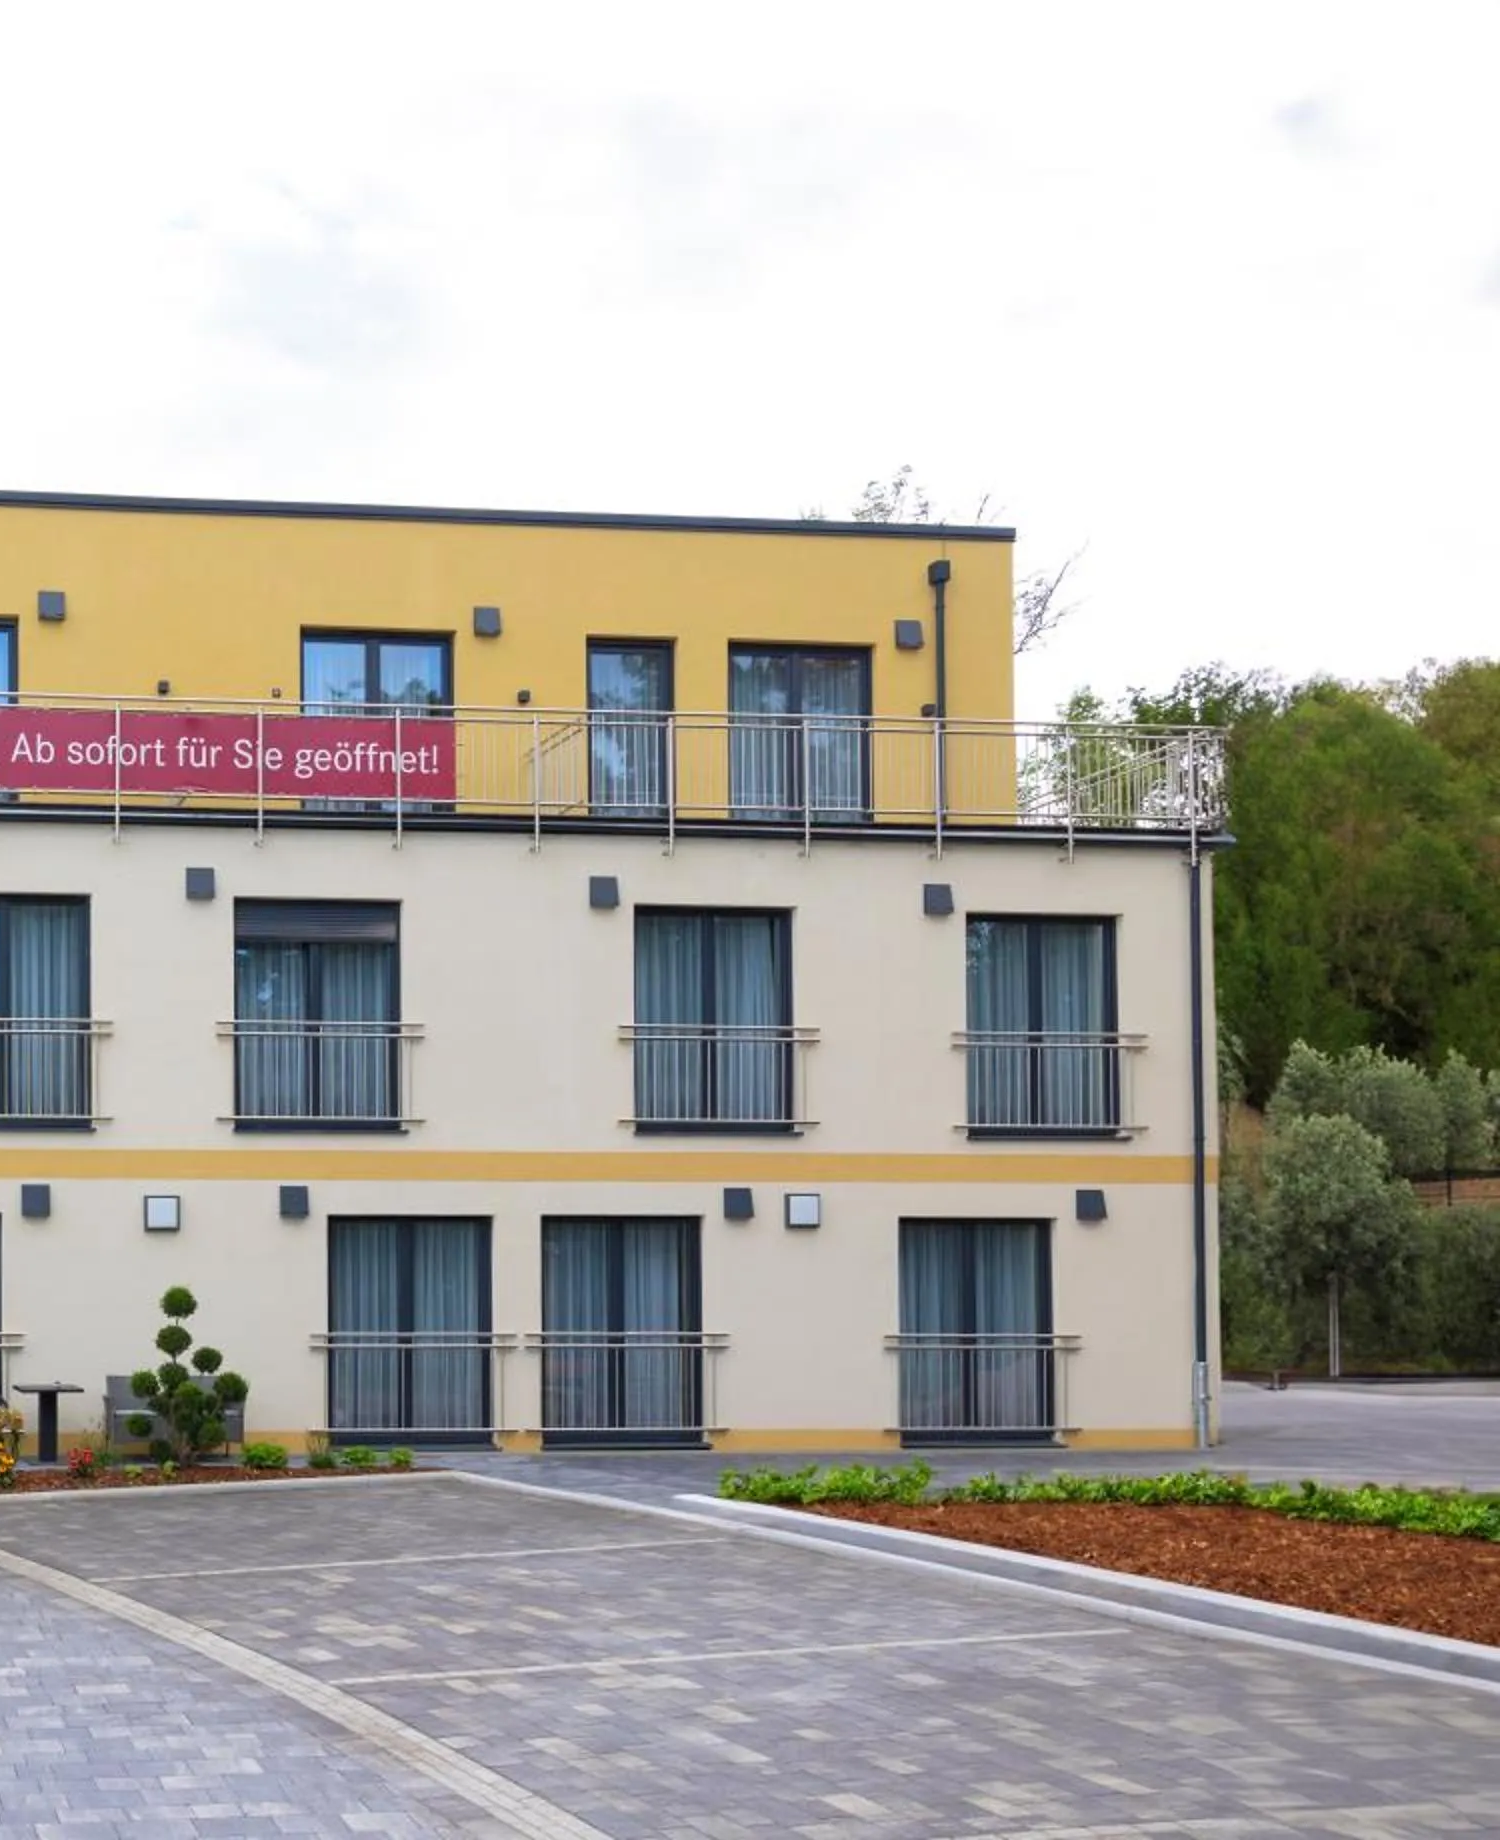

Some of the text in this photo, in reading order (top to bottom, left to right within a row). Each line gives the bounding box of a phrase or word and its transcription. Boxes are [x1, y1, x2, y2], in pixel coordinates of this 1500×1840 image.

[11, 731, 440, 779] Ab sofort für Se geöffnet!
